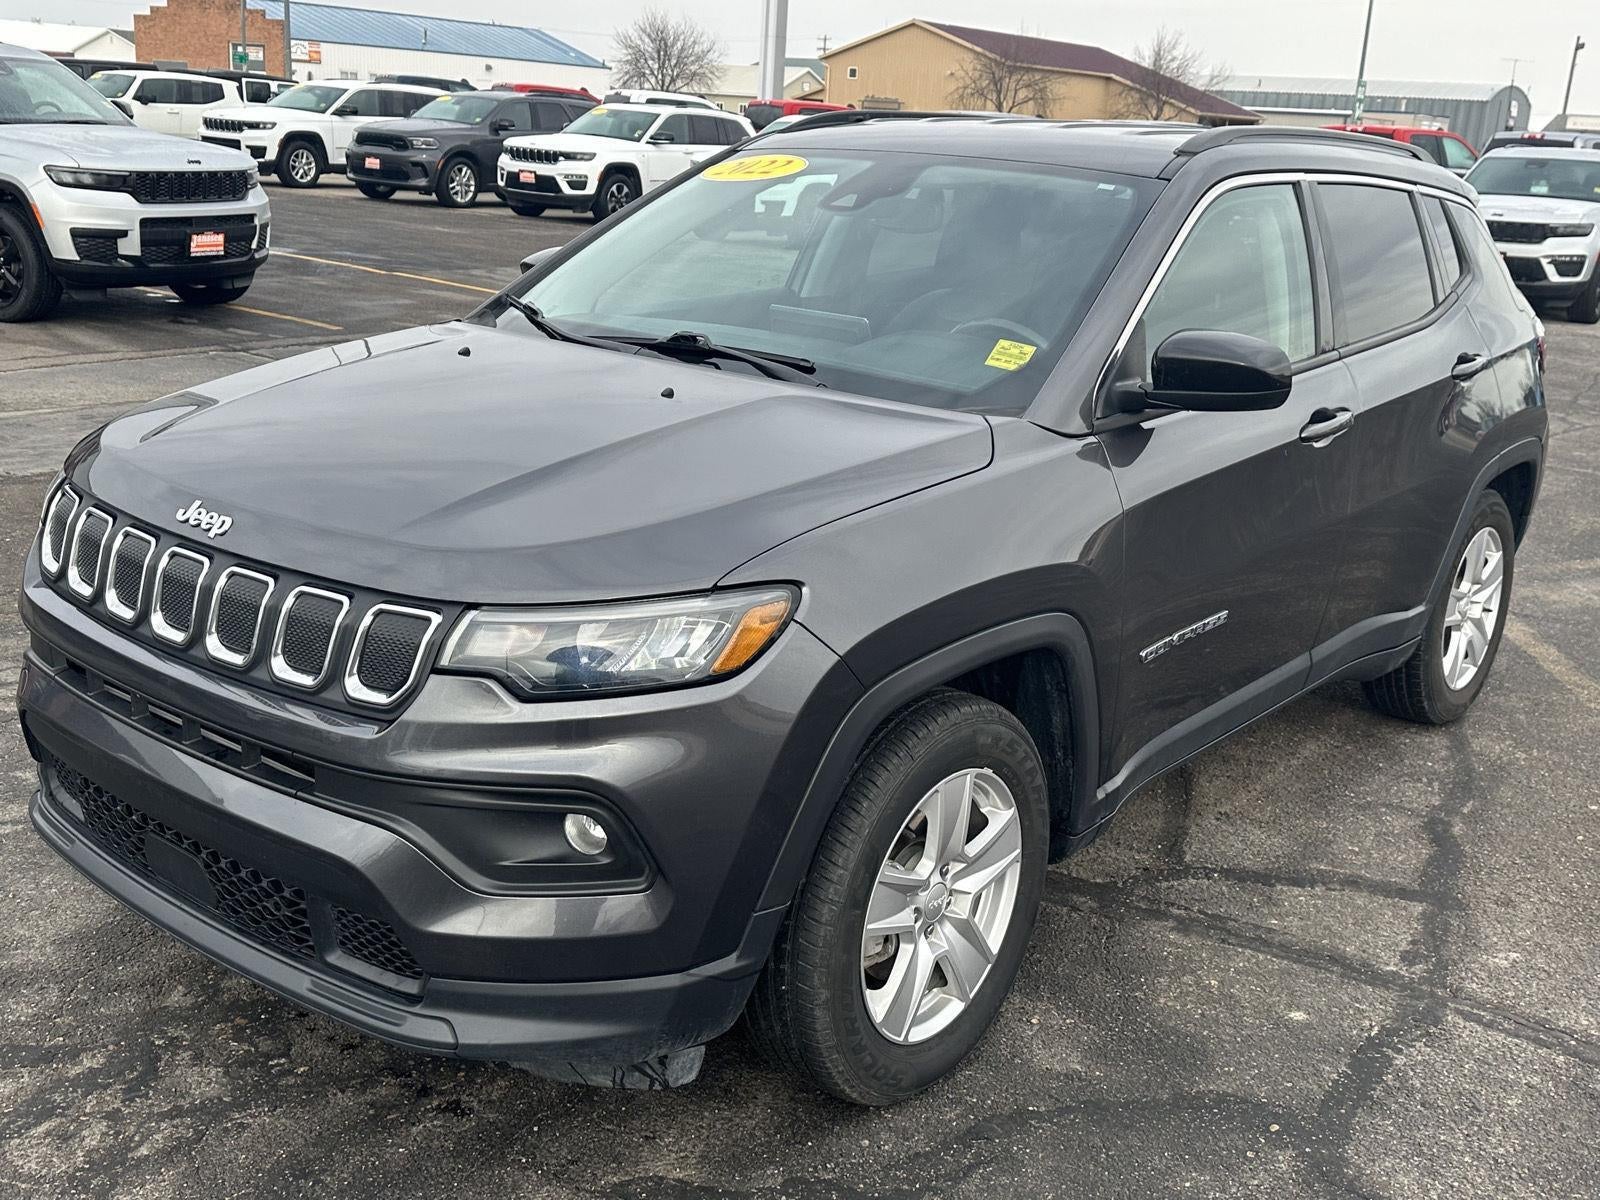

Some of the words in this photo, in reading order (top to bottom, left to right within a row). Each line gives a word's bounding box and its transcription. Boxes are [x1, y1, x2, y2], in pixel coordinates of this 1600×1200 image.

[711, 159, 795, 176] 2022
[176, 500, 233, 539] Jeep
[1139, 610, 1229, 663] COMPASS
